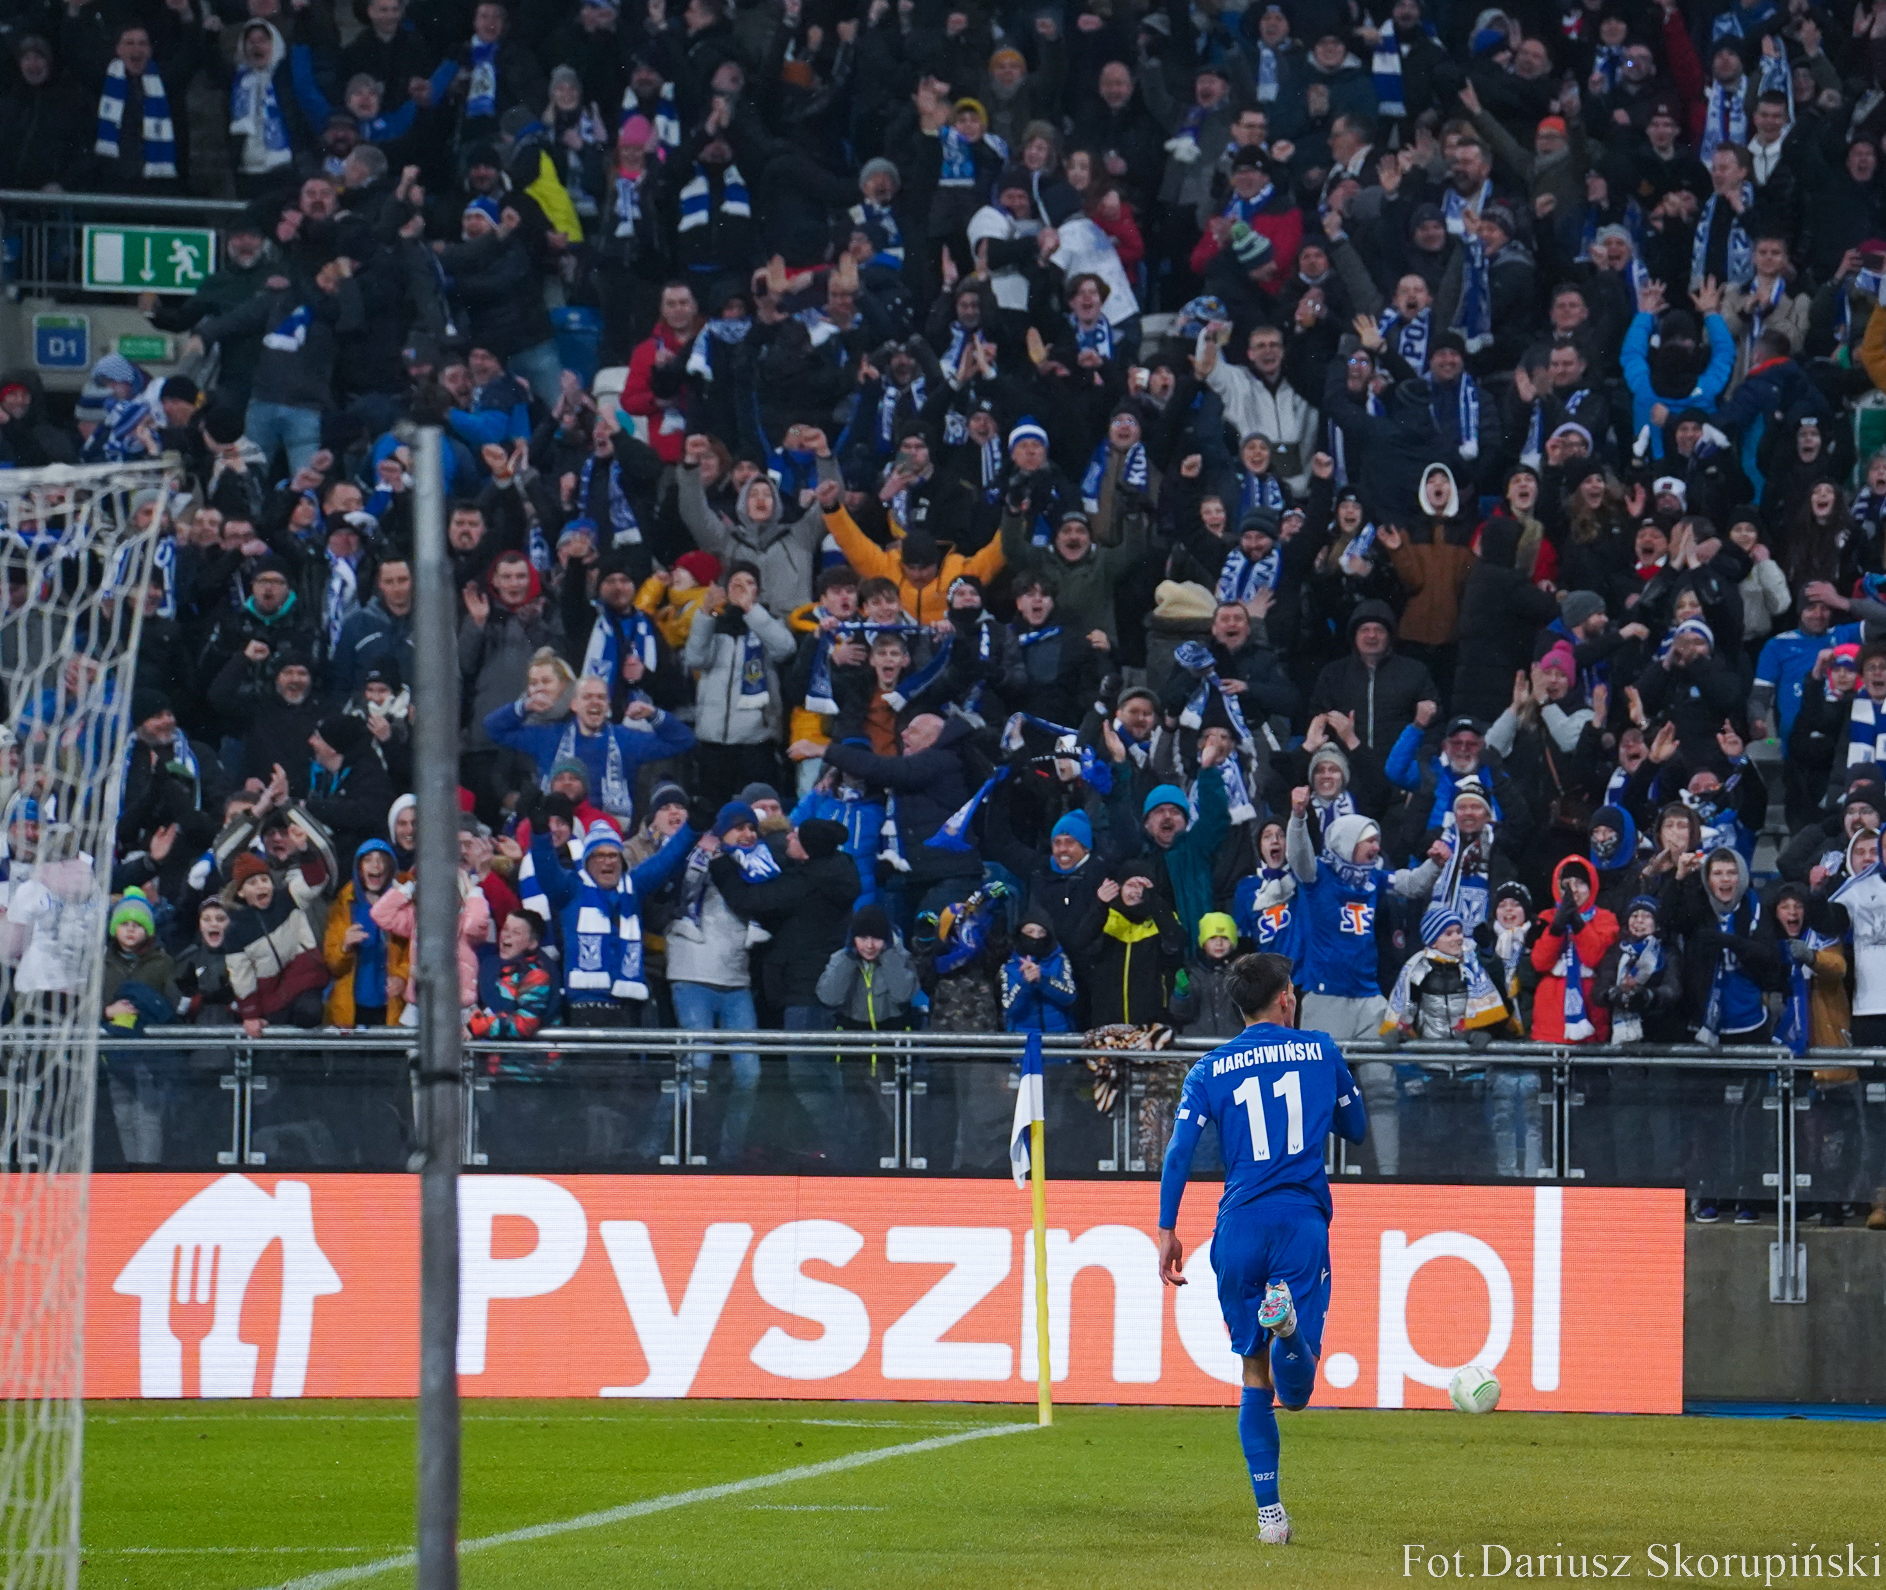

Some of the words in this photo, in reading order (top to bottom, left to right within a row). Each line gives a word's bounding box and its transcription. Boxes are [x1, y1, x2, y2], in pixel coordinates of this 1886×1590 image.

[49, 337, 77, 358] D1
[1340, 901, 1374, 936] STS
[1212, 1040, 1323, 1078] MARCHWIŃSKI
[1232, 1070, 1304, 1162] 11
[1253, 1471, 1275, 1482] 1922
